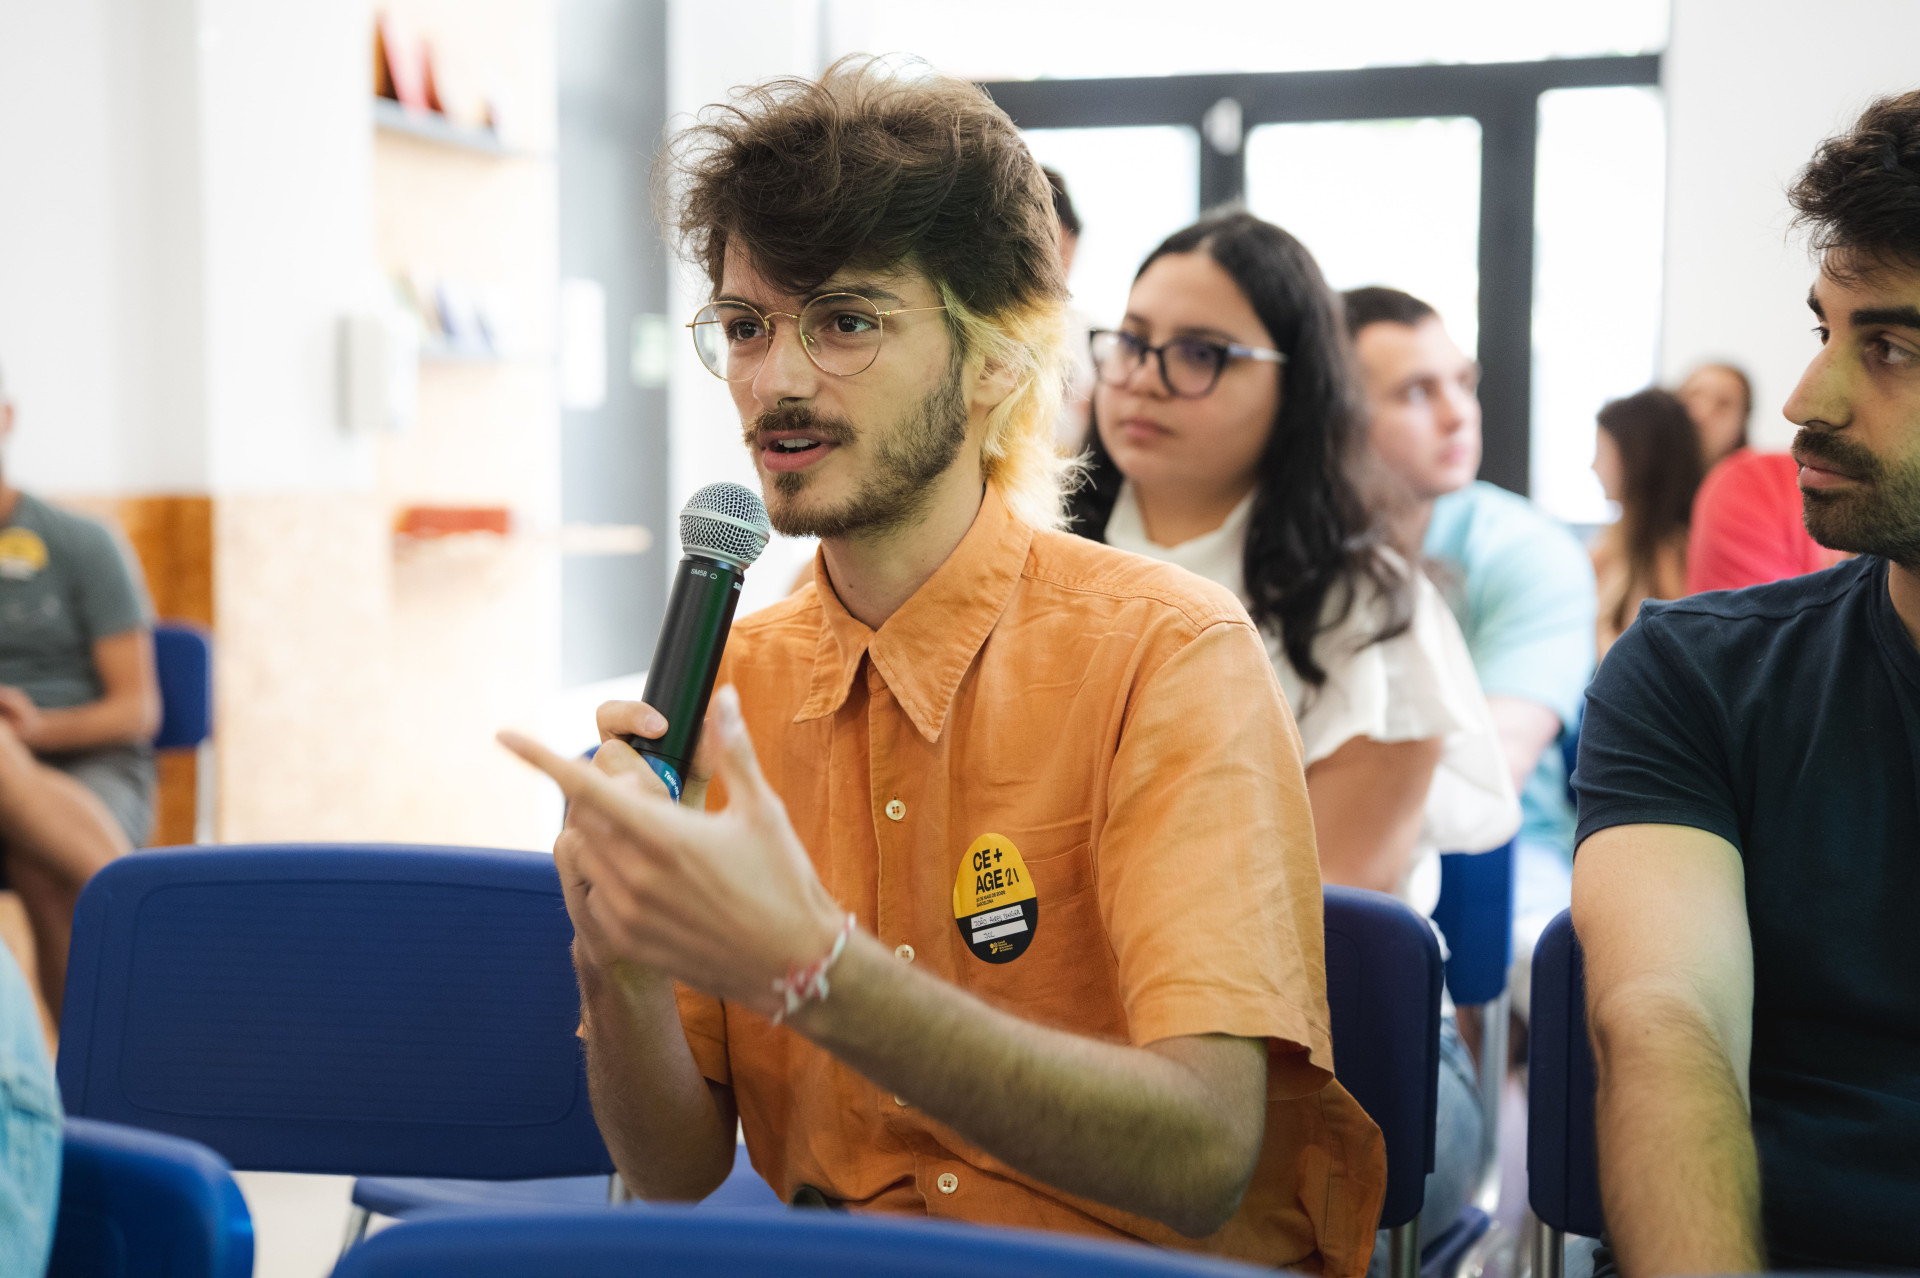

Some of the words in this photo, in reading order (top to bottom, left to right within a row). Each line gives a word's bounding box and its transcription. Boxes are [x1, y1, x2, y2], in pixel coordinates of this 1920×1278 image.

[690, 568, 708, 577] SM58
[973, 849, 991, 872] CE
[976, 868, 1004, 895] AGE
